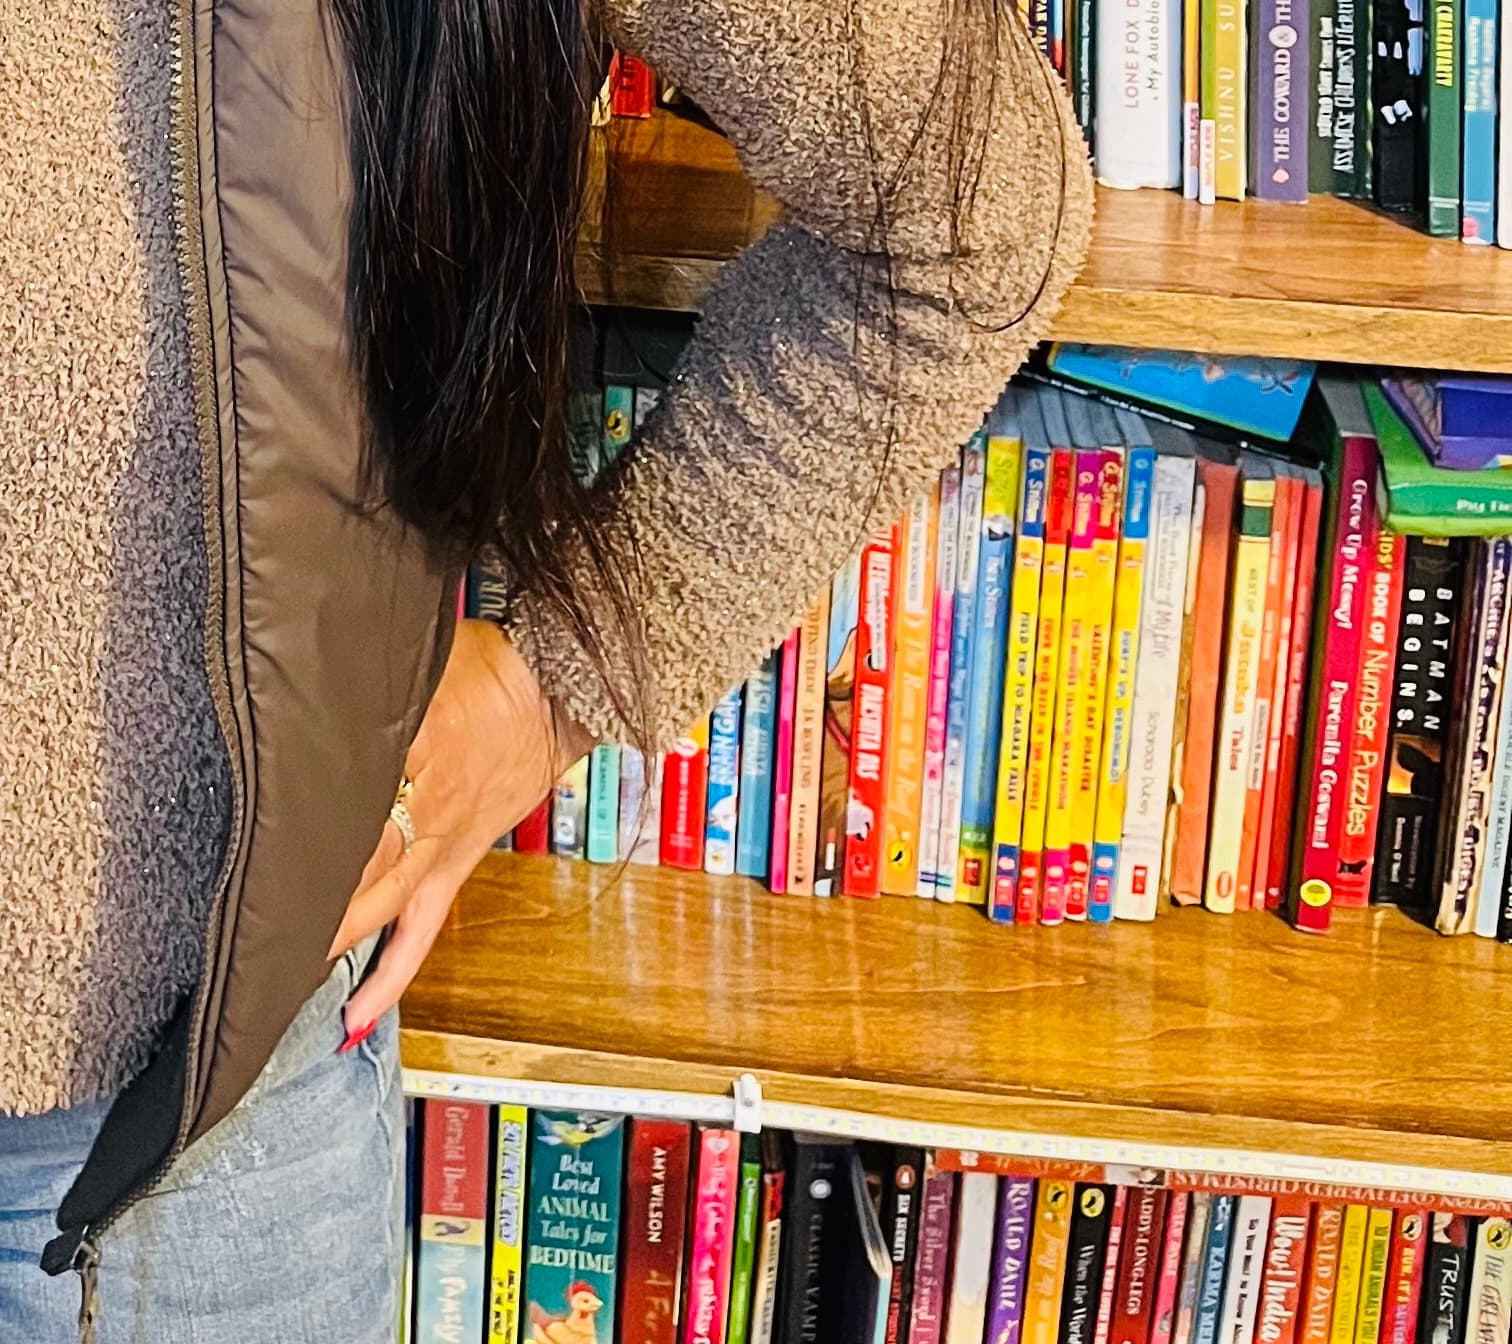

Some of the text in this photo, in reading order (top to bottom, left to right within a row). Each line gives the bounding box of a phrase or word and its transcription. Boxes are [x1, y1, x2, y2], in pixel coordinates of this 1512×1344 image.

[1334, 478, 1368, 630] Grow Up Messy!
[1423, 587, 1453, 730] BATMAN
[1346, 649, 1387, 836] Number Puzzles
[559, 1154, 594, 1175] Best
[551, 1173, 601, 1197] Loved
[648, 1146, 667, 1244] AMY WILSON
[538, 1195, 612, 1223] ANIMAL
[540, 1219, 609, 1247] Tales for
[530, 1243, 616, 1274] BEDTIME
